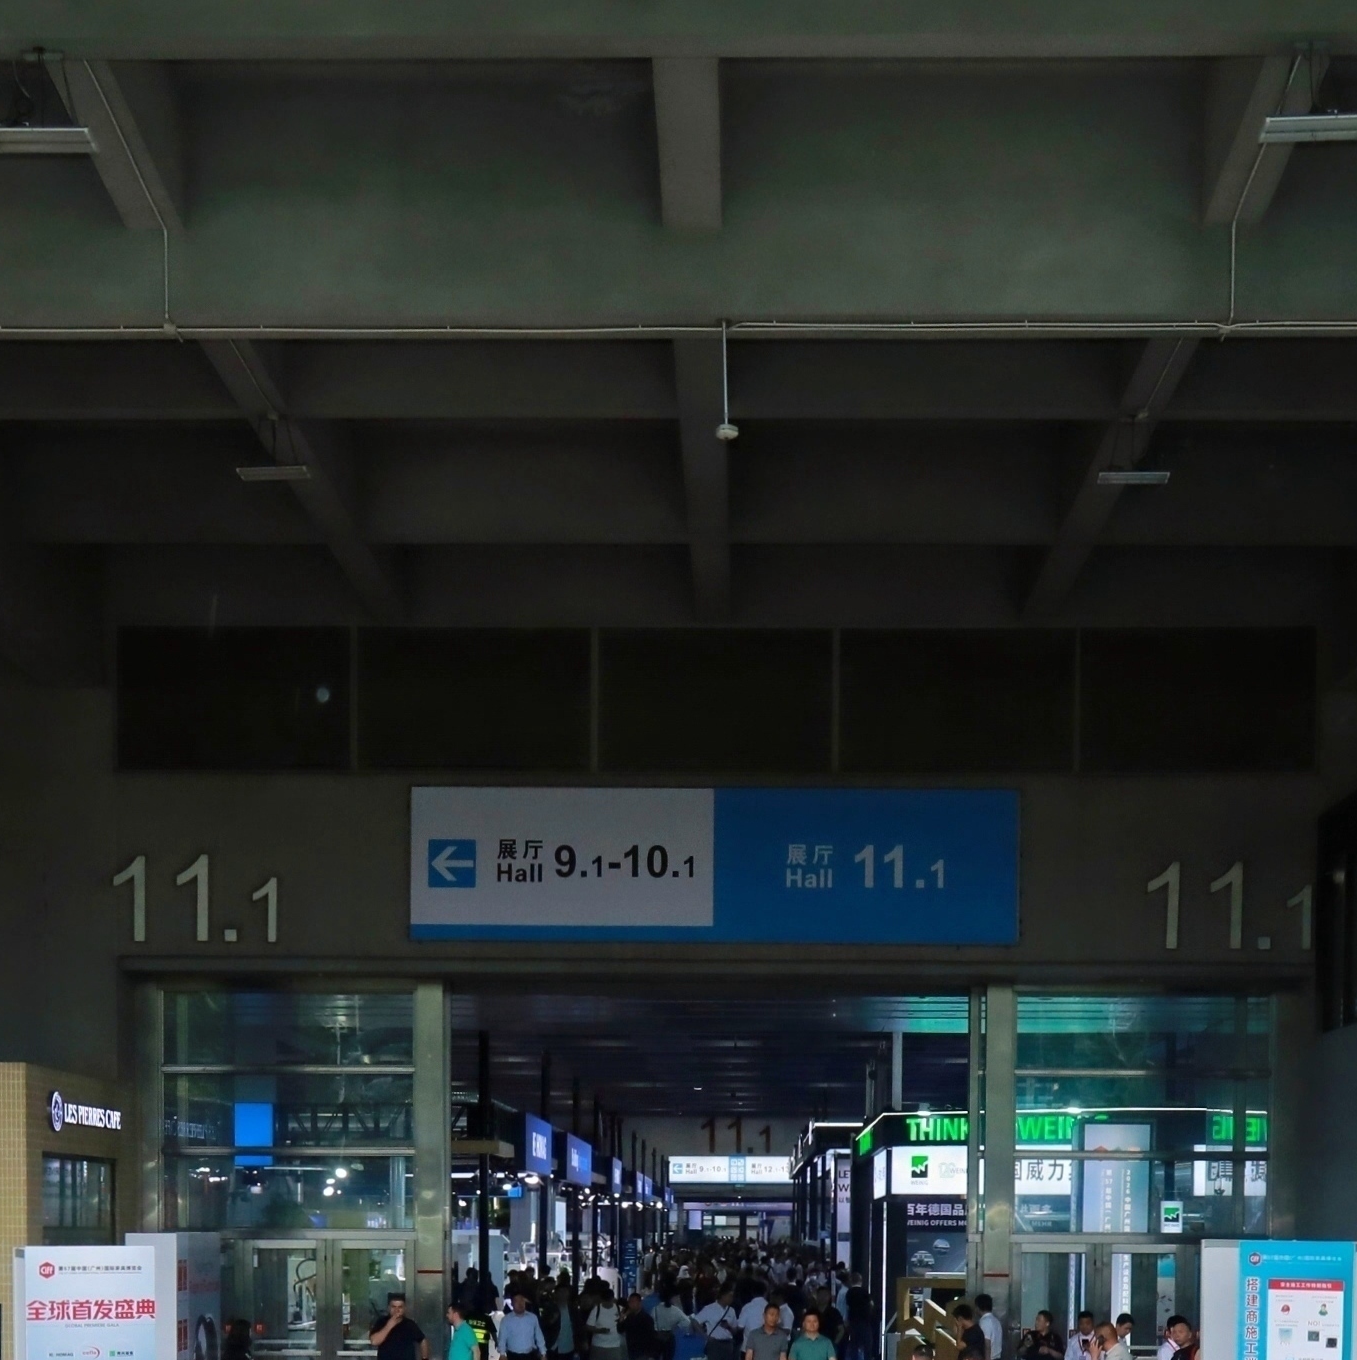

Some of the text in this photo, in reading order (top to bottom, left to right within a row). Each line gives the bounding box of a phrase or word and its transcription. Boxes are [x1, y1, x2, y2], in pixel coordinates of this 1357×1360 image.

[497, 838, 543, 859] 展厅
[786, 844, 833, 865] 展厅
[497, 844, 694, 882] Hall 9.1-10.1
[786, 844, 944, 889] Hall 11.1
[113, 853, 278, 942] 11.1
[1147, 861, 1313, 949] 11.1
[64, 1103, 122, 1130] LES PIERRES CAFE
[701, 1117, 771, 1154] 11.1
[907, 1203, 967, 1216] 百年德国品
[930, 1219, 957, 1227] OFFERS
[26, 1299, 155, 1321] 全球首发盛典
